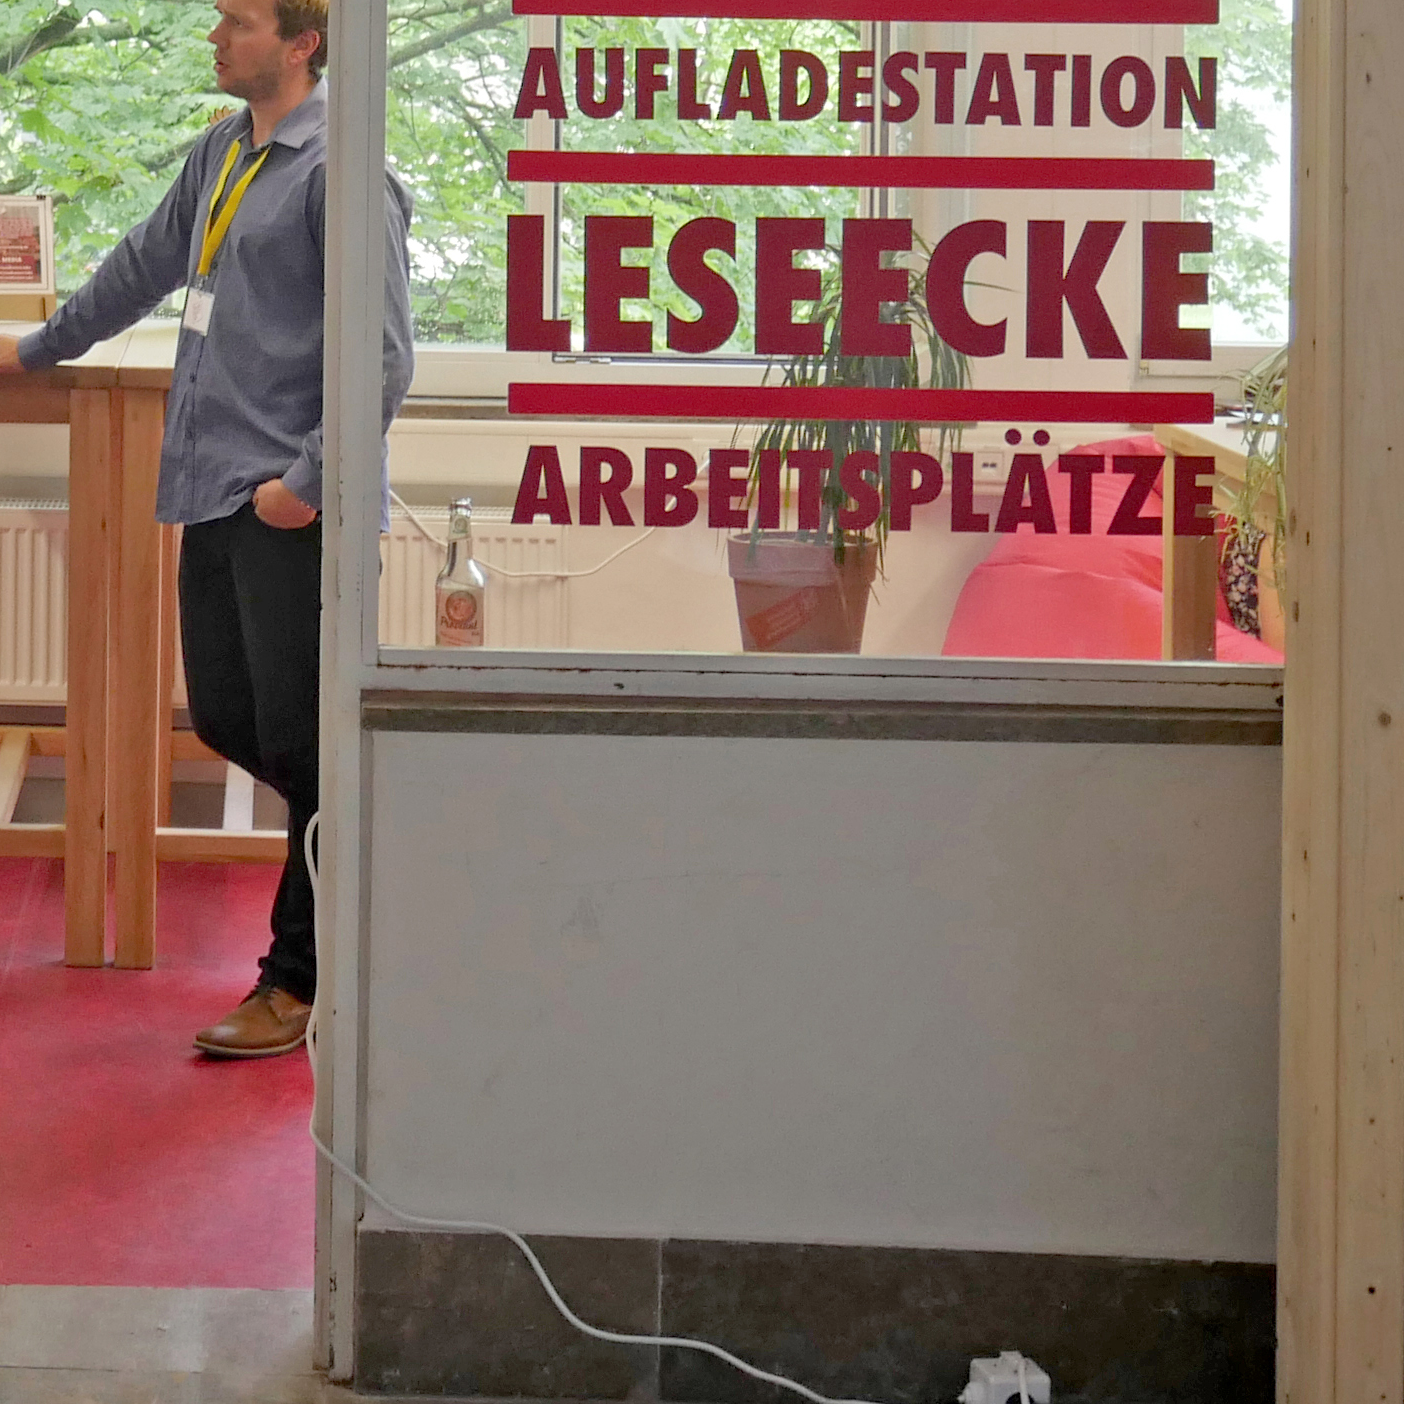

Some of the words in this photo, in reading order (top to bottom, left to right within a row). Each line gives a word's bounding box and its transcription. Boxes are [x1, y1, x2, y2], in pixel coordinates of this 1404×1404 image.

[513, 47, 1217, 130] AUFLADESTATION
[505, 214, 1214, 362] LESEECKE
[510, 428, 1216, 537] ARBEITSPLÄTZE
